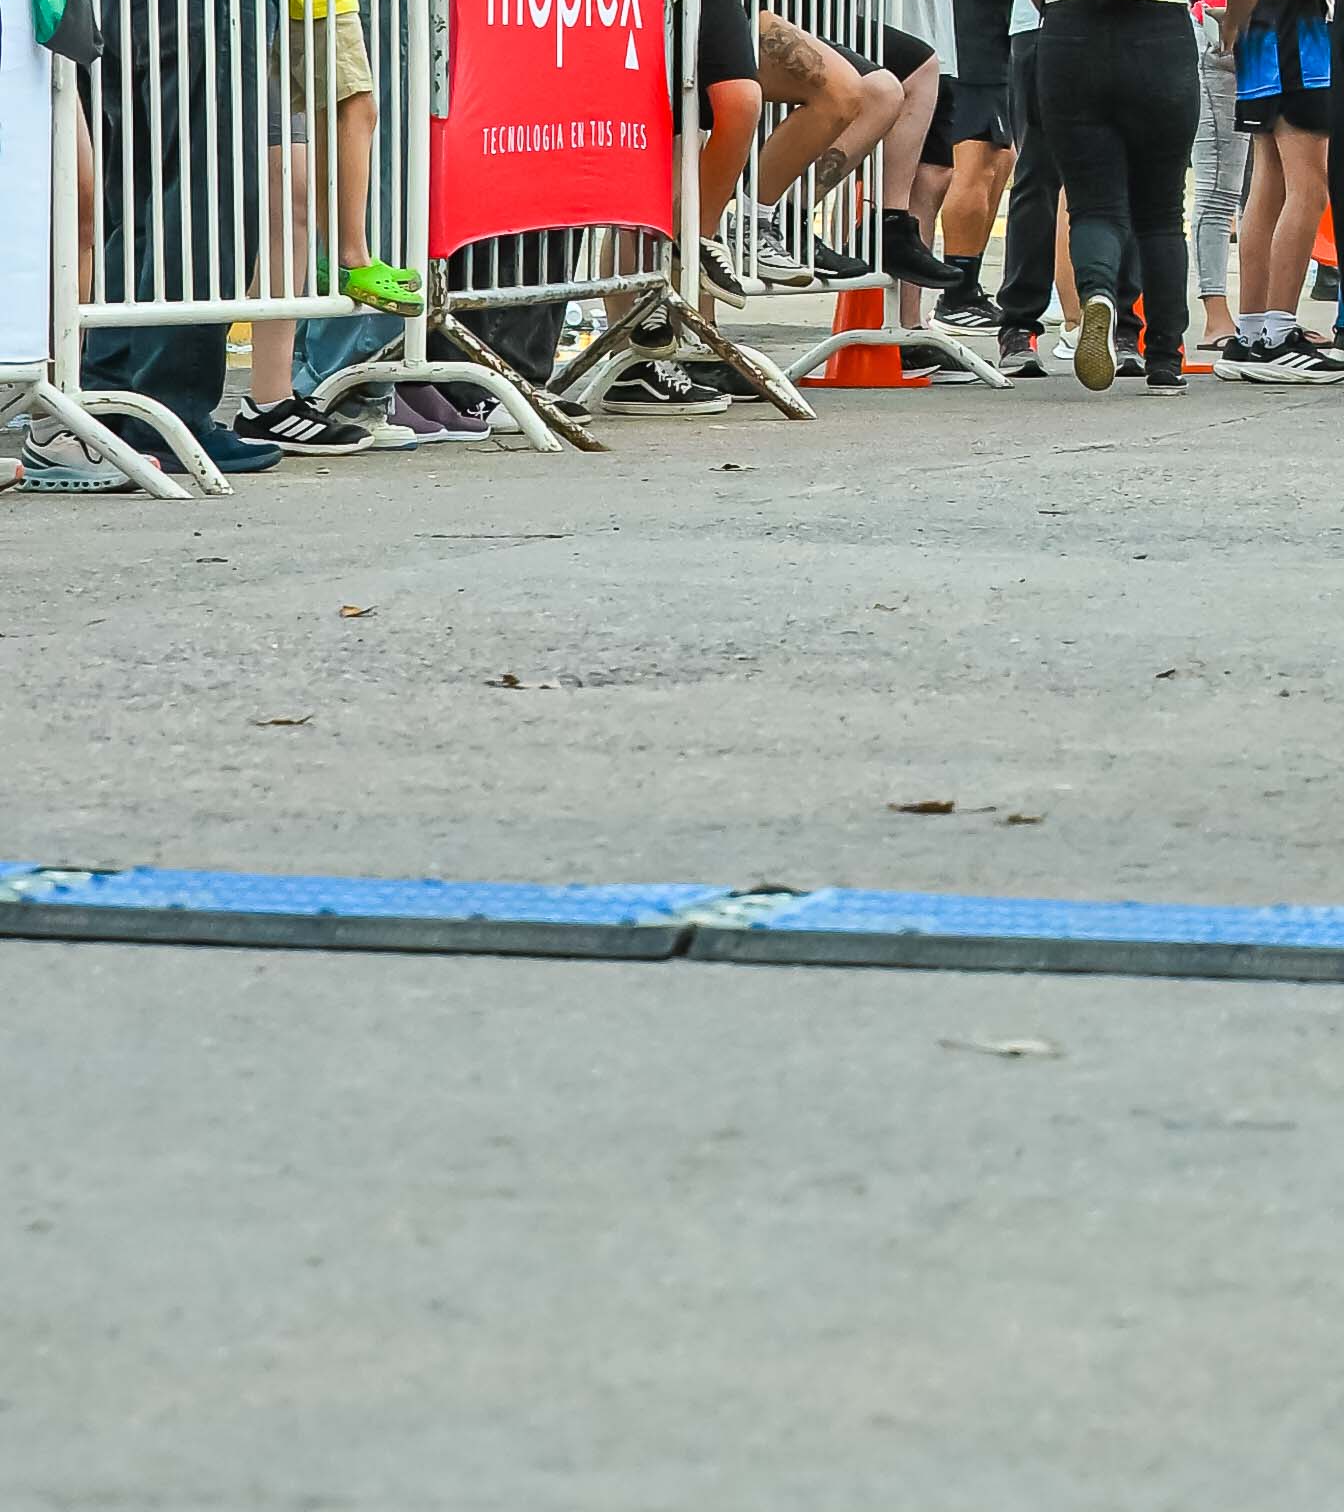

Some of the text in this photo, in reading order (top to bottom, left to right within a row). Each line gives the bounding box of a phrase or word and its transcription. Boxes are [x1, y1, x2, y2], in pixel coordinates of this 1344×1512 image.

[483, 120, 647, 155] TECNOLOGIA EN TUS PIES
